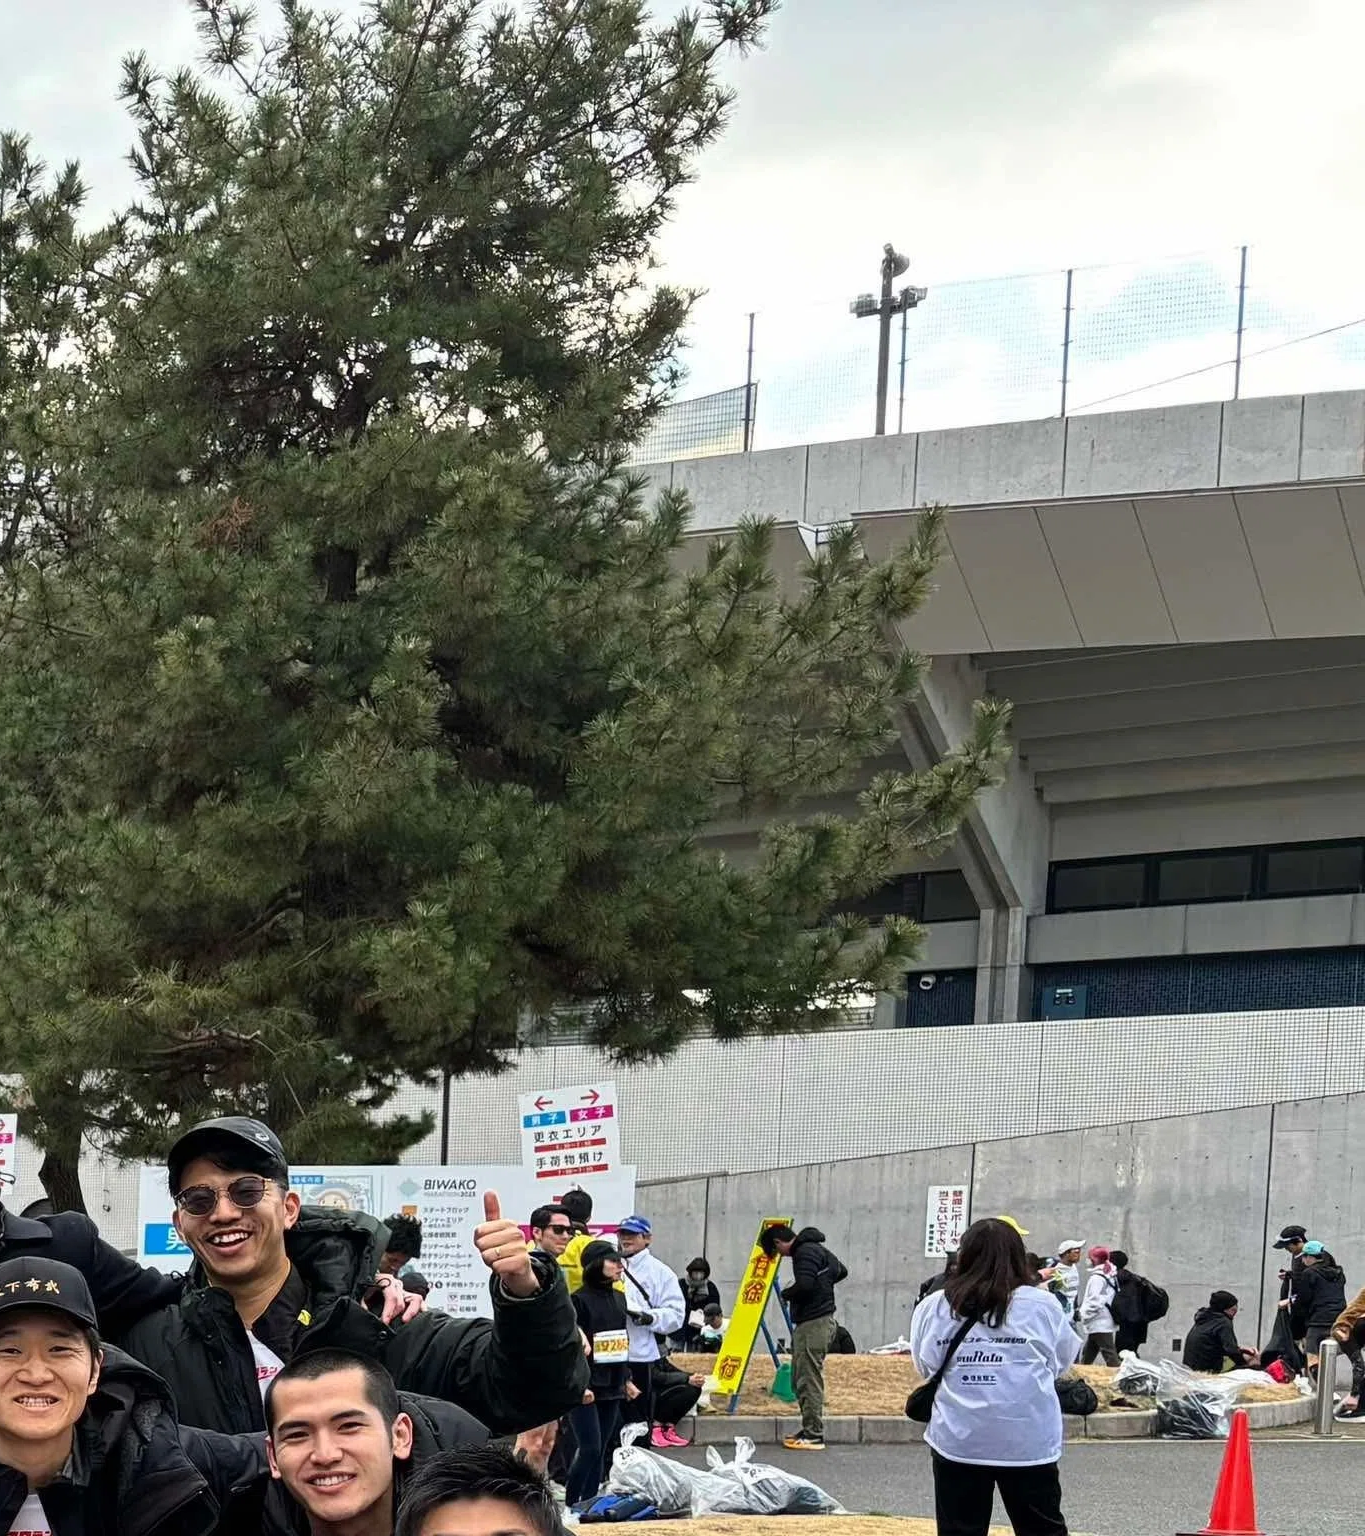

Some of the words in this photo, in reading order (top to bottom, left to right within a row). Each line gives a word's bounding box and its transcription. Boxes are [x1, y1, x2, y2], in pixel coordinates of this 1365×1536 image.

[534, 1125, 602, 1143] 更衣エリア
[536, 1151, 604, 1169] 手荷物預け
[423, 1179, 477, 1190] BIWAKO
